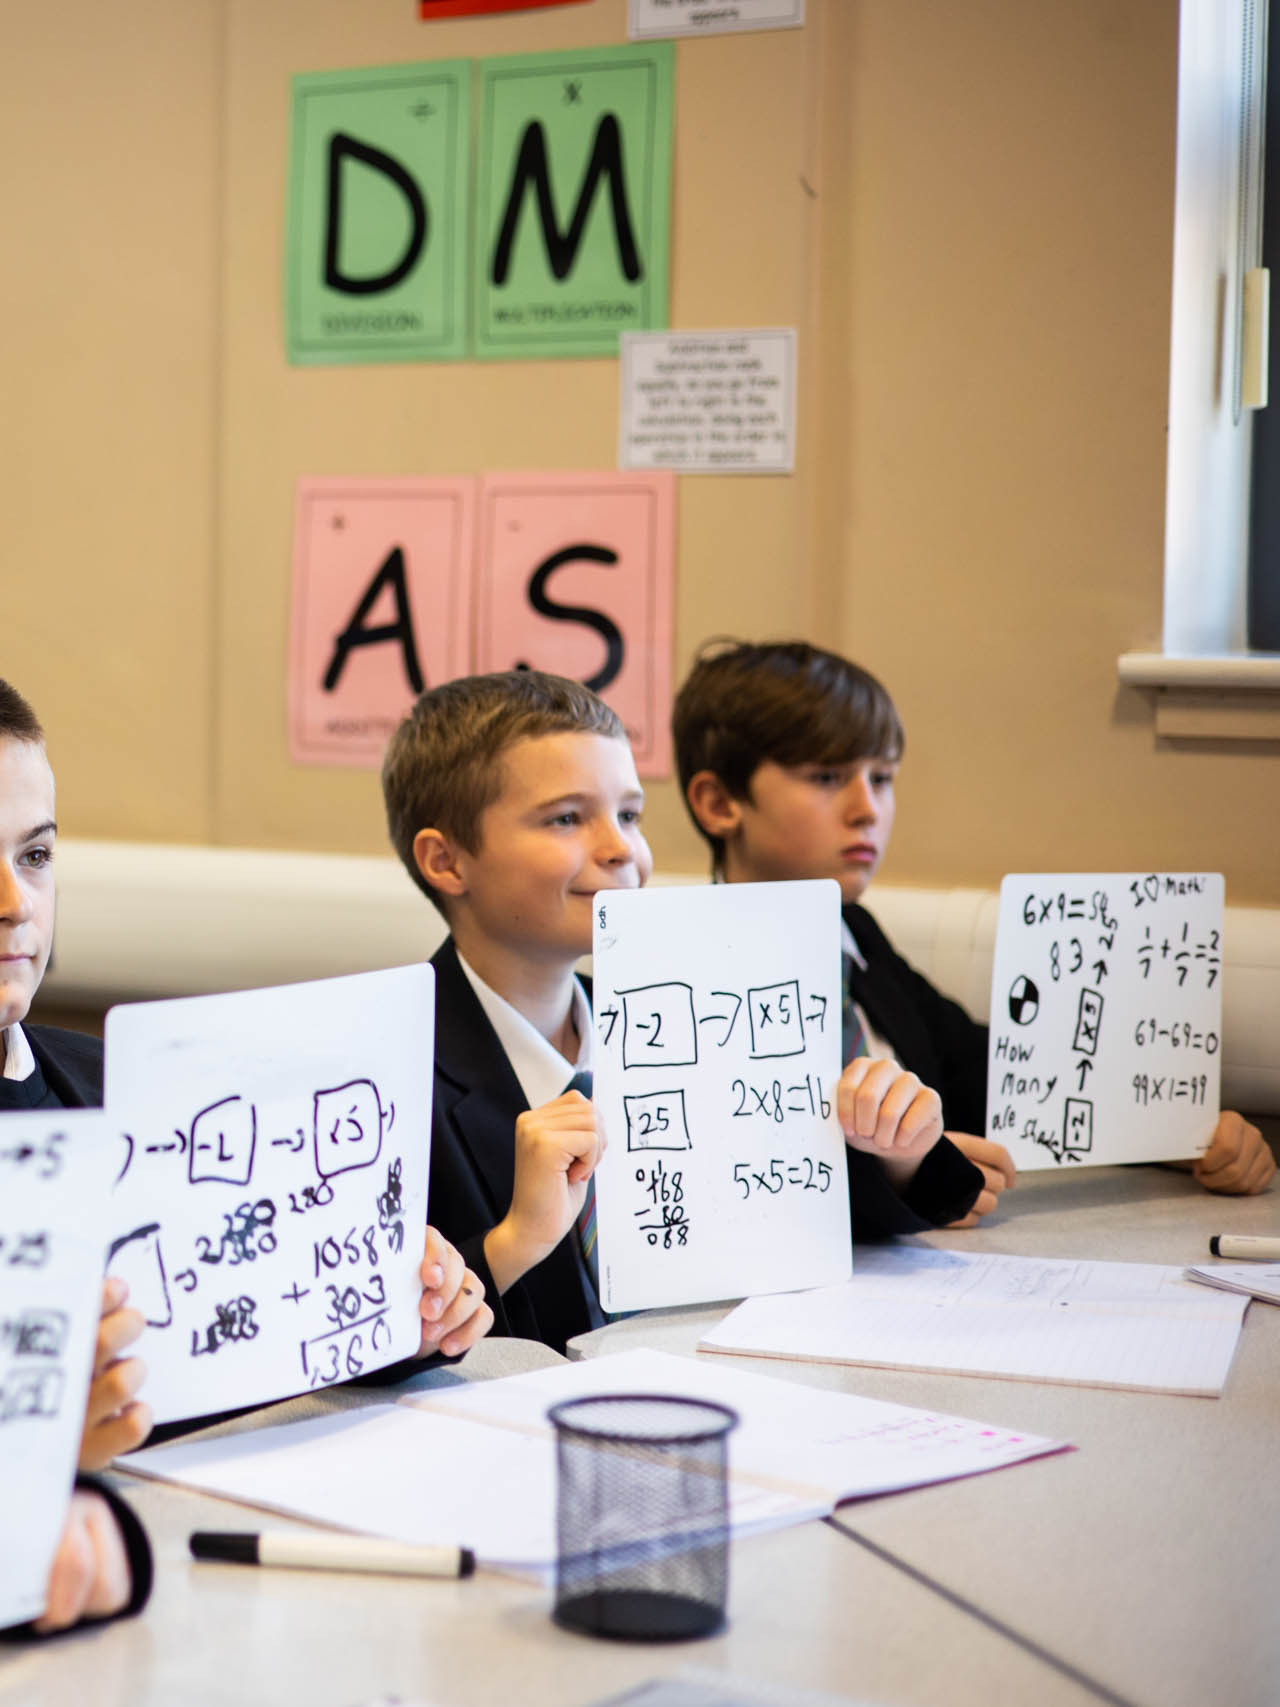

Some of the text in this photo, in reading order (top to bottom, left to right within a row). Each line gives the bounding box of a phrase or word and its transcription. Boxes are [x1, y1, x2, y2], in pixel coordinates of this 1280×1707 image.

[322, 132, 428, 296] D
[490, 112, 644, 287] M
[322, 545, 427, 697] A
[515, 542, 626, 696] S
[638, 1106, 671, 1136] 25
